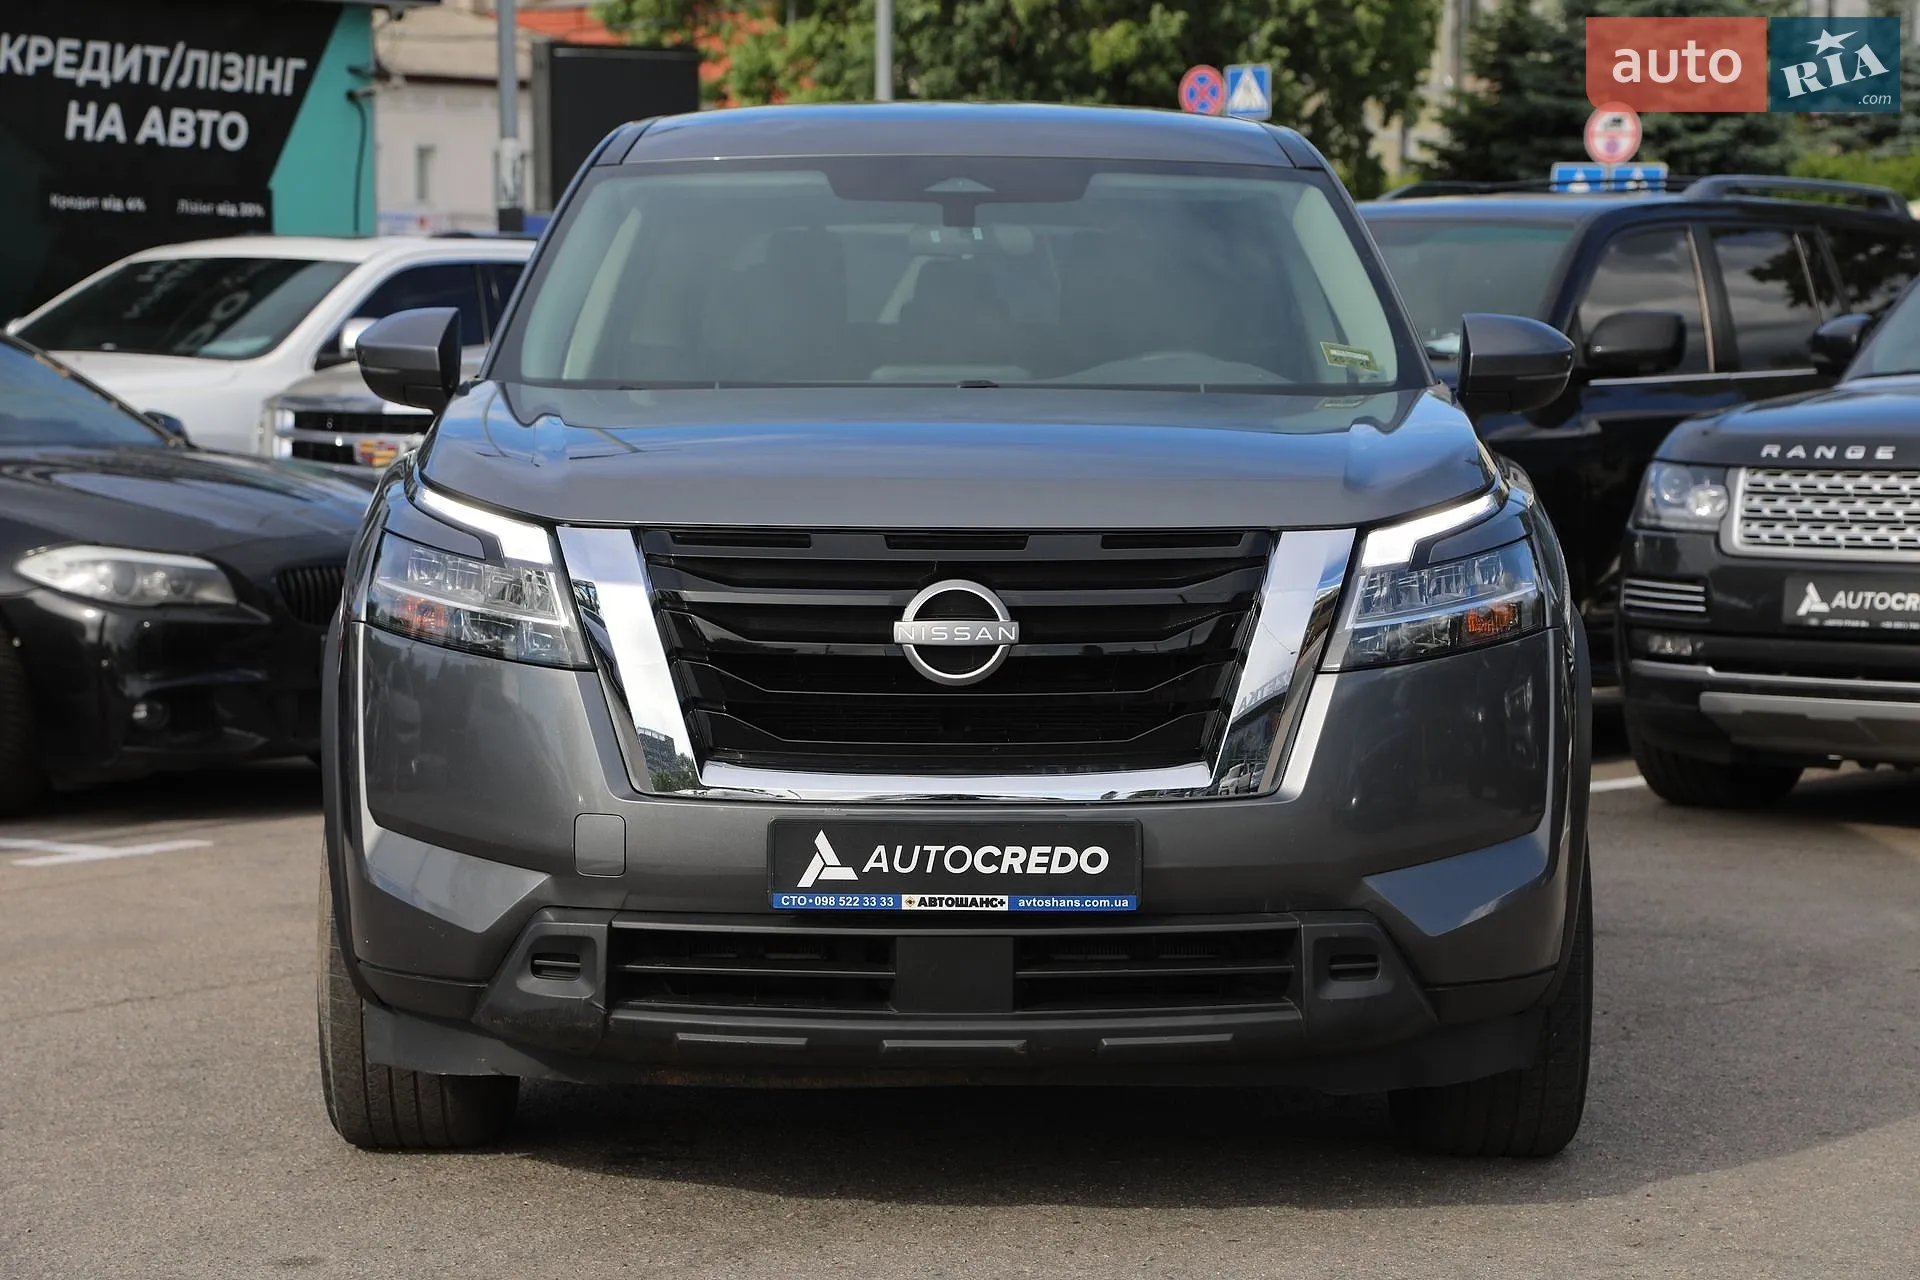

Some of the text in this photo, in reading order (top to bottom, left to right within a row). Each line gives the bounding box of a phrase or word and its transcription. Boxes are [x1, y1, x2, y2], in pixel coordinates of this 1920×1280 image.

[0, 32, 307, 97] КРЕДИТ/ЛІЗІНГ
[64, 99, 250, 152] НА АВТО
[1760, 444, 1896, 460] RANGE
[898, 626, 1016, 641] NISSAN
[862, 844, 1110, 876] AUTOCREDO
[838, 896, 860, 907] 522
[863, 897, 877, 907] 33
[880, 897, 894, 907] 33
[1018, 896, 1129, 908] avtoshans.com.ua
